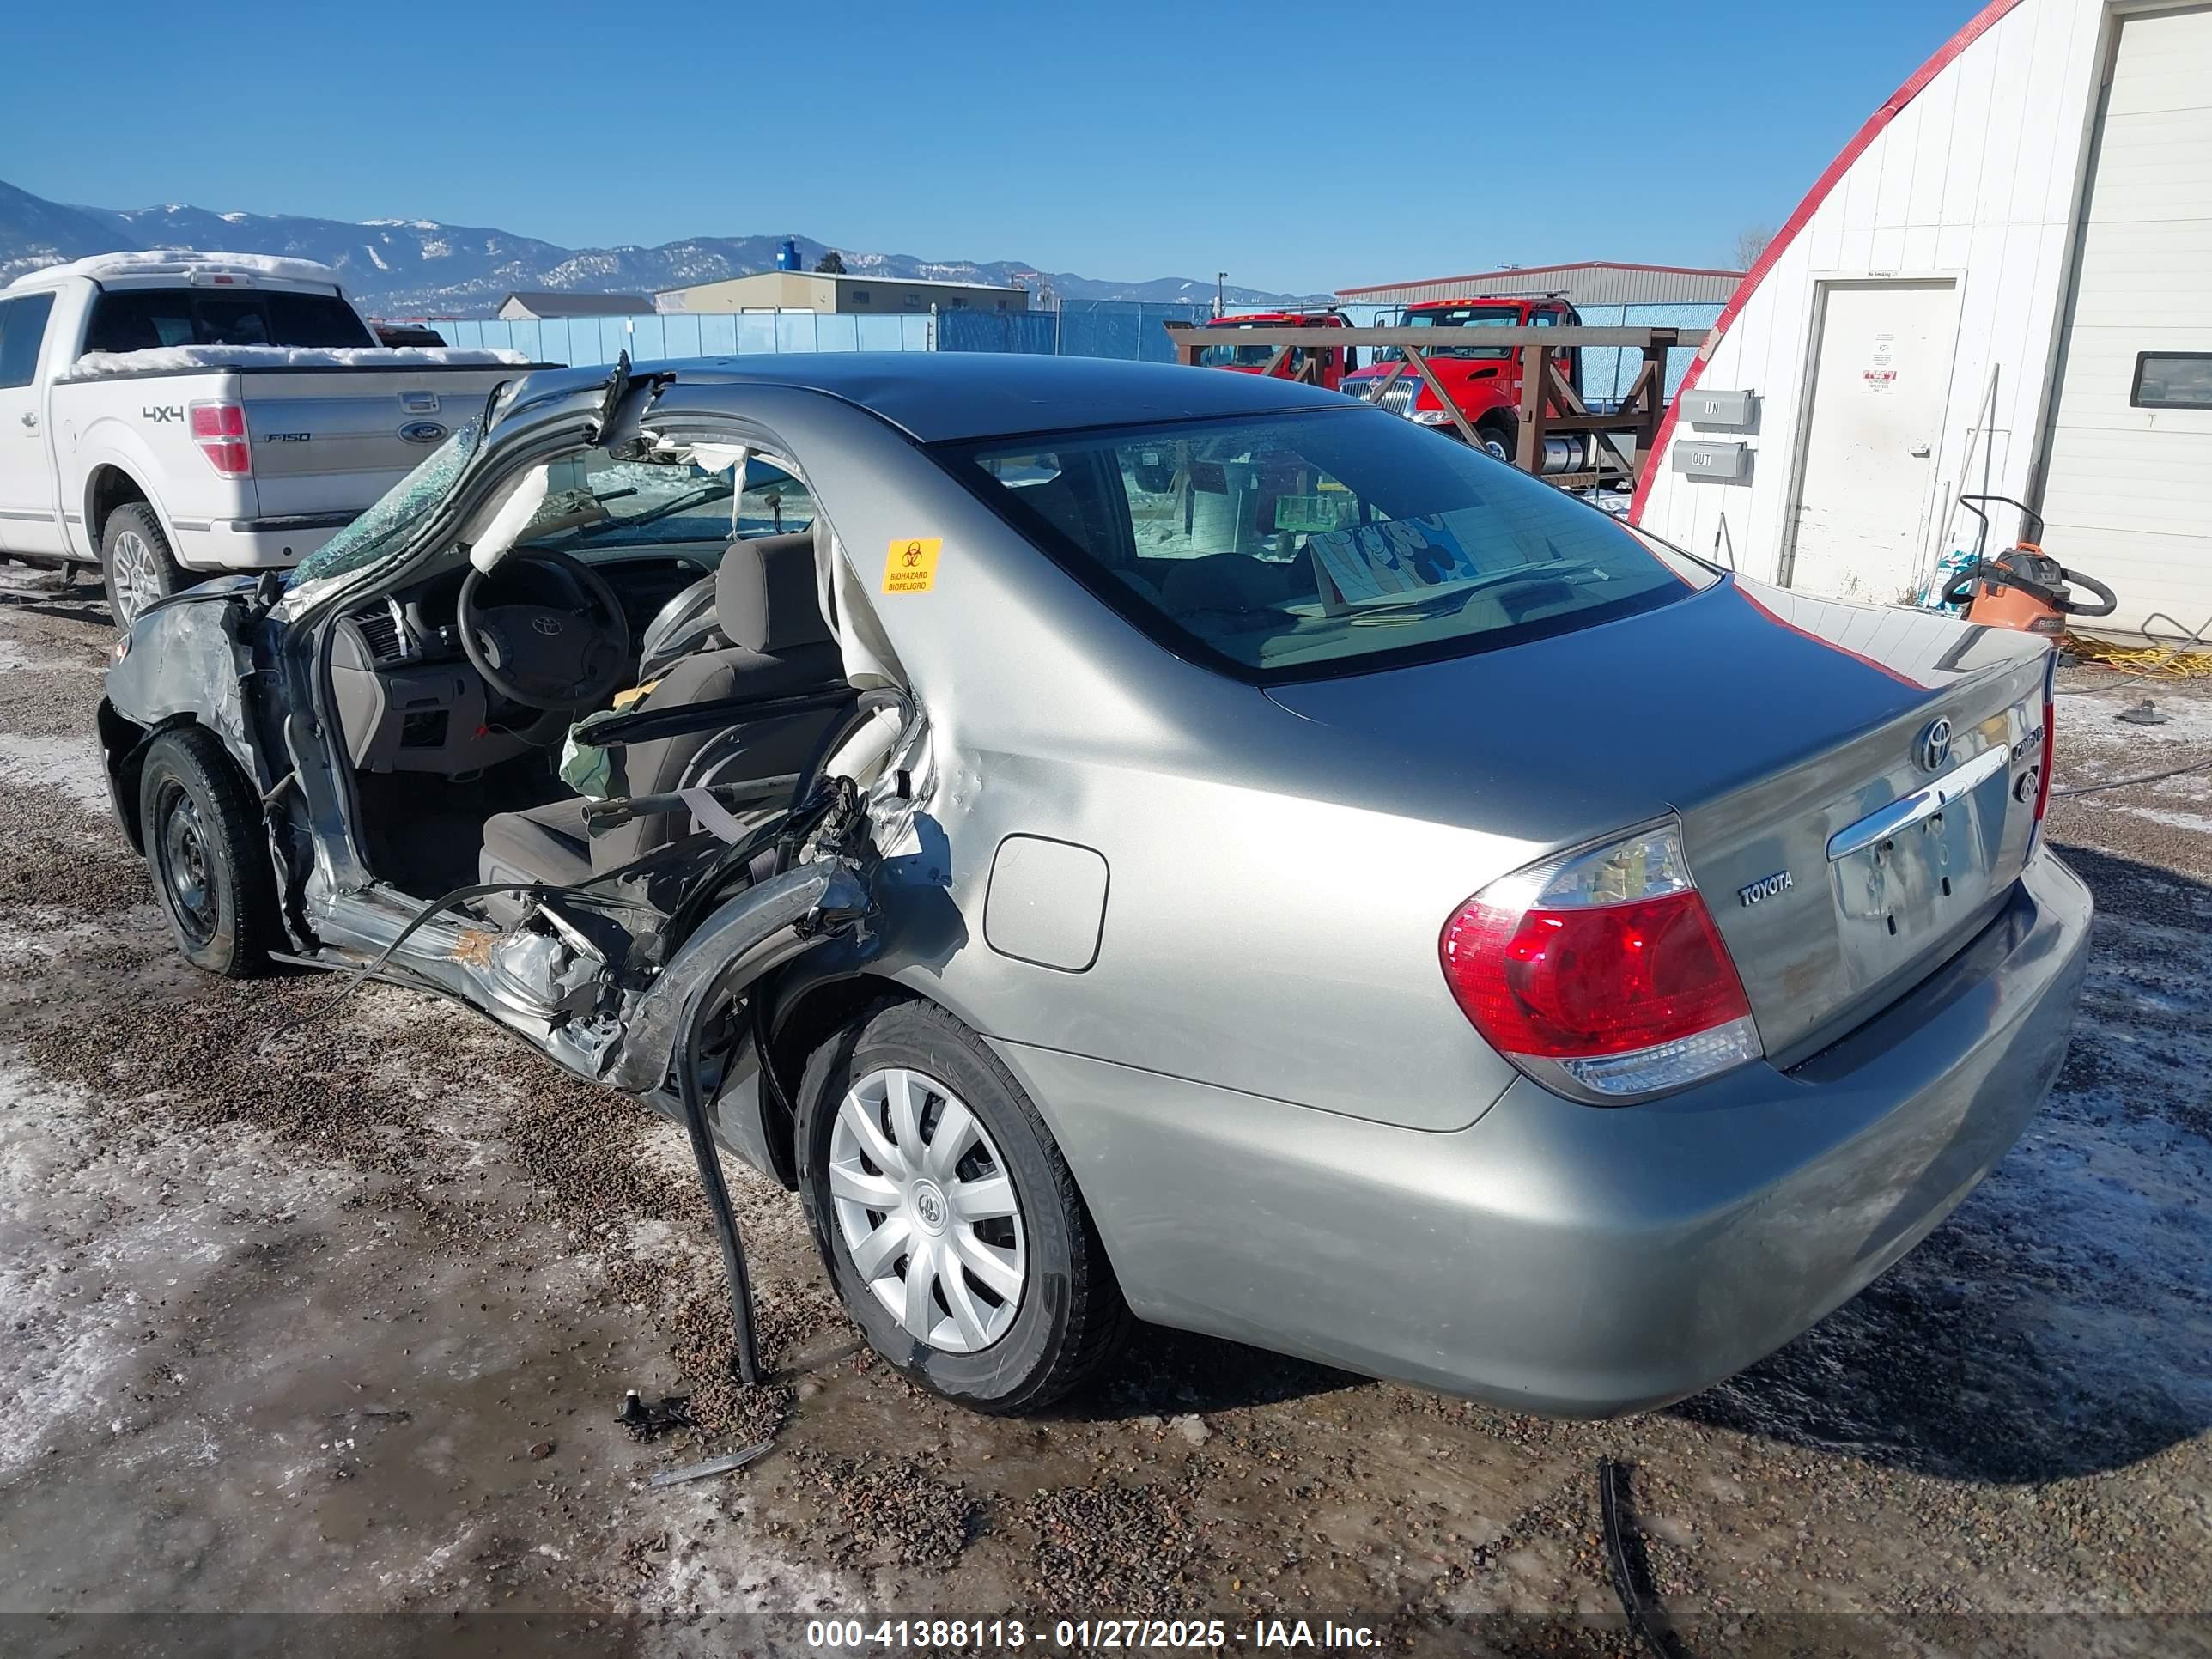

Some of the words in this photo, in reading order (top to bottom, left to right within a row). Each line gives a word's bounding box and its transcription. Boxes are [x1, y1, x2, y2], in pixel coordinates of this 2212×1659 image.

[143, 405, 184, 422] 4X4
[1707, 401, 1719, 414] IN
[1692, 453, 1711, 465] OUT
[890, 571, 927, 580] BIOHAZARD
[888, 582, 927, 591] BIOPELIGRO
[1740, 871, 1794, 907] TOYOTA
